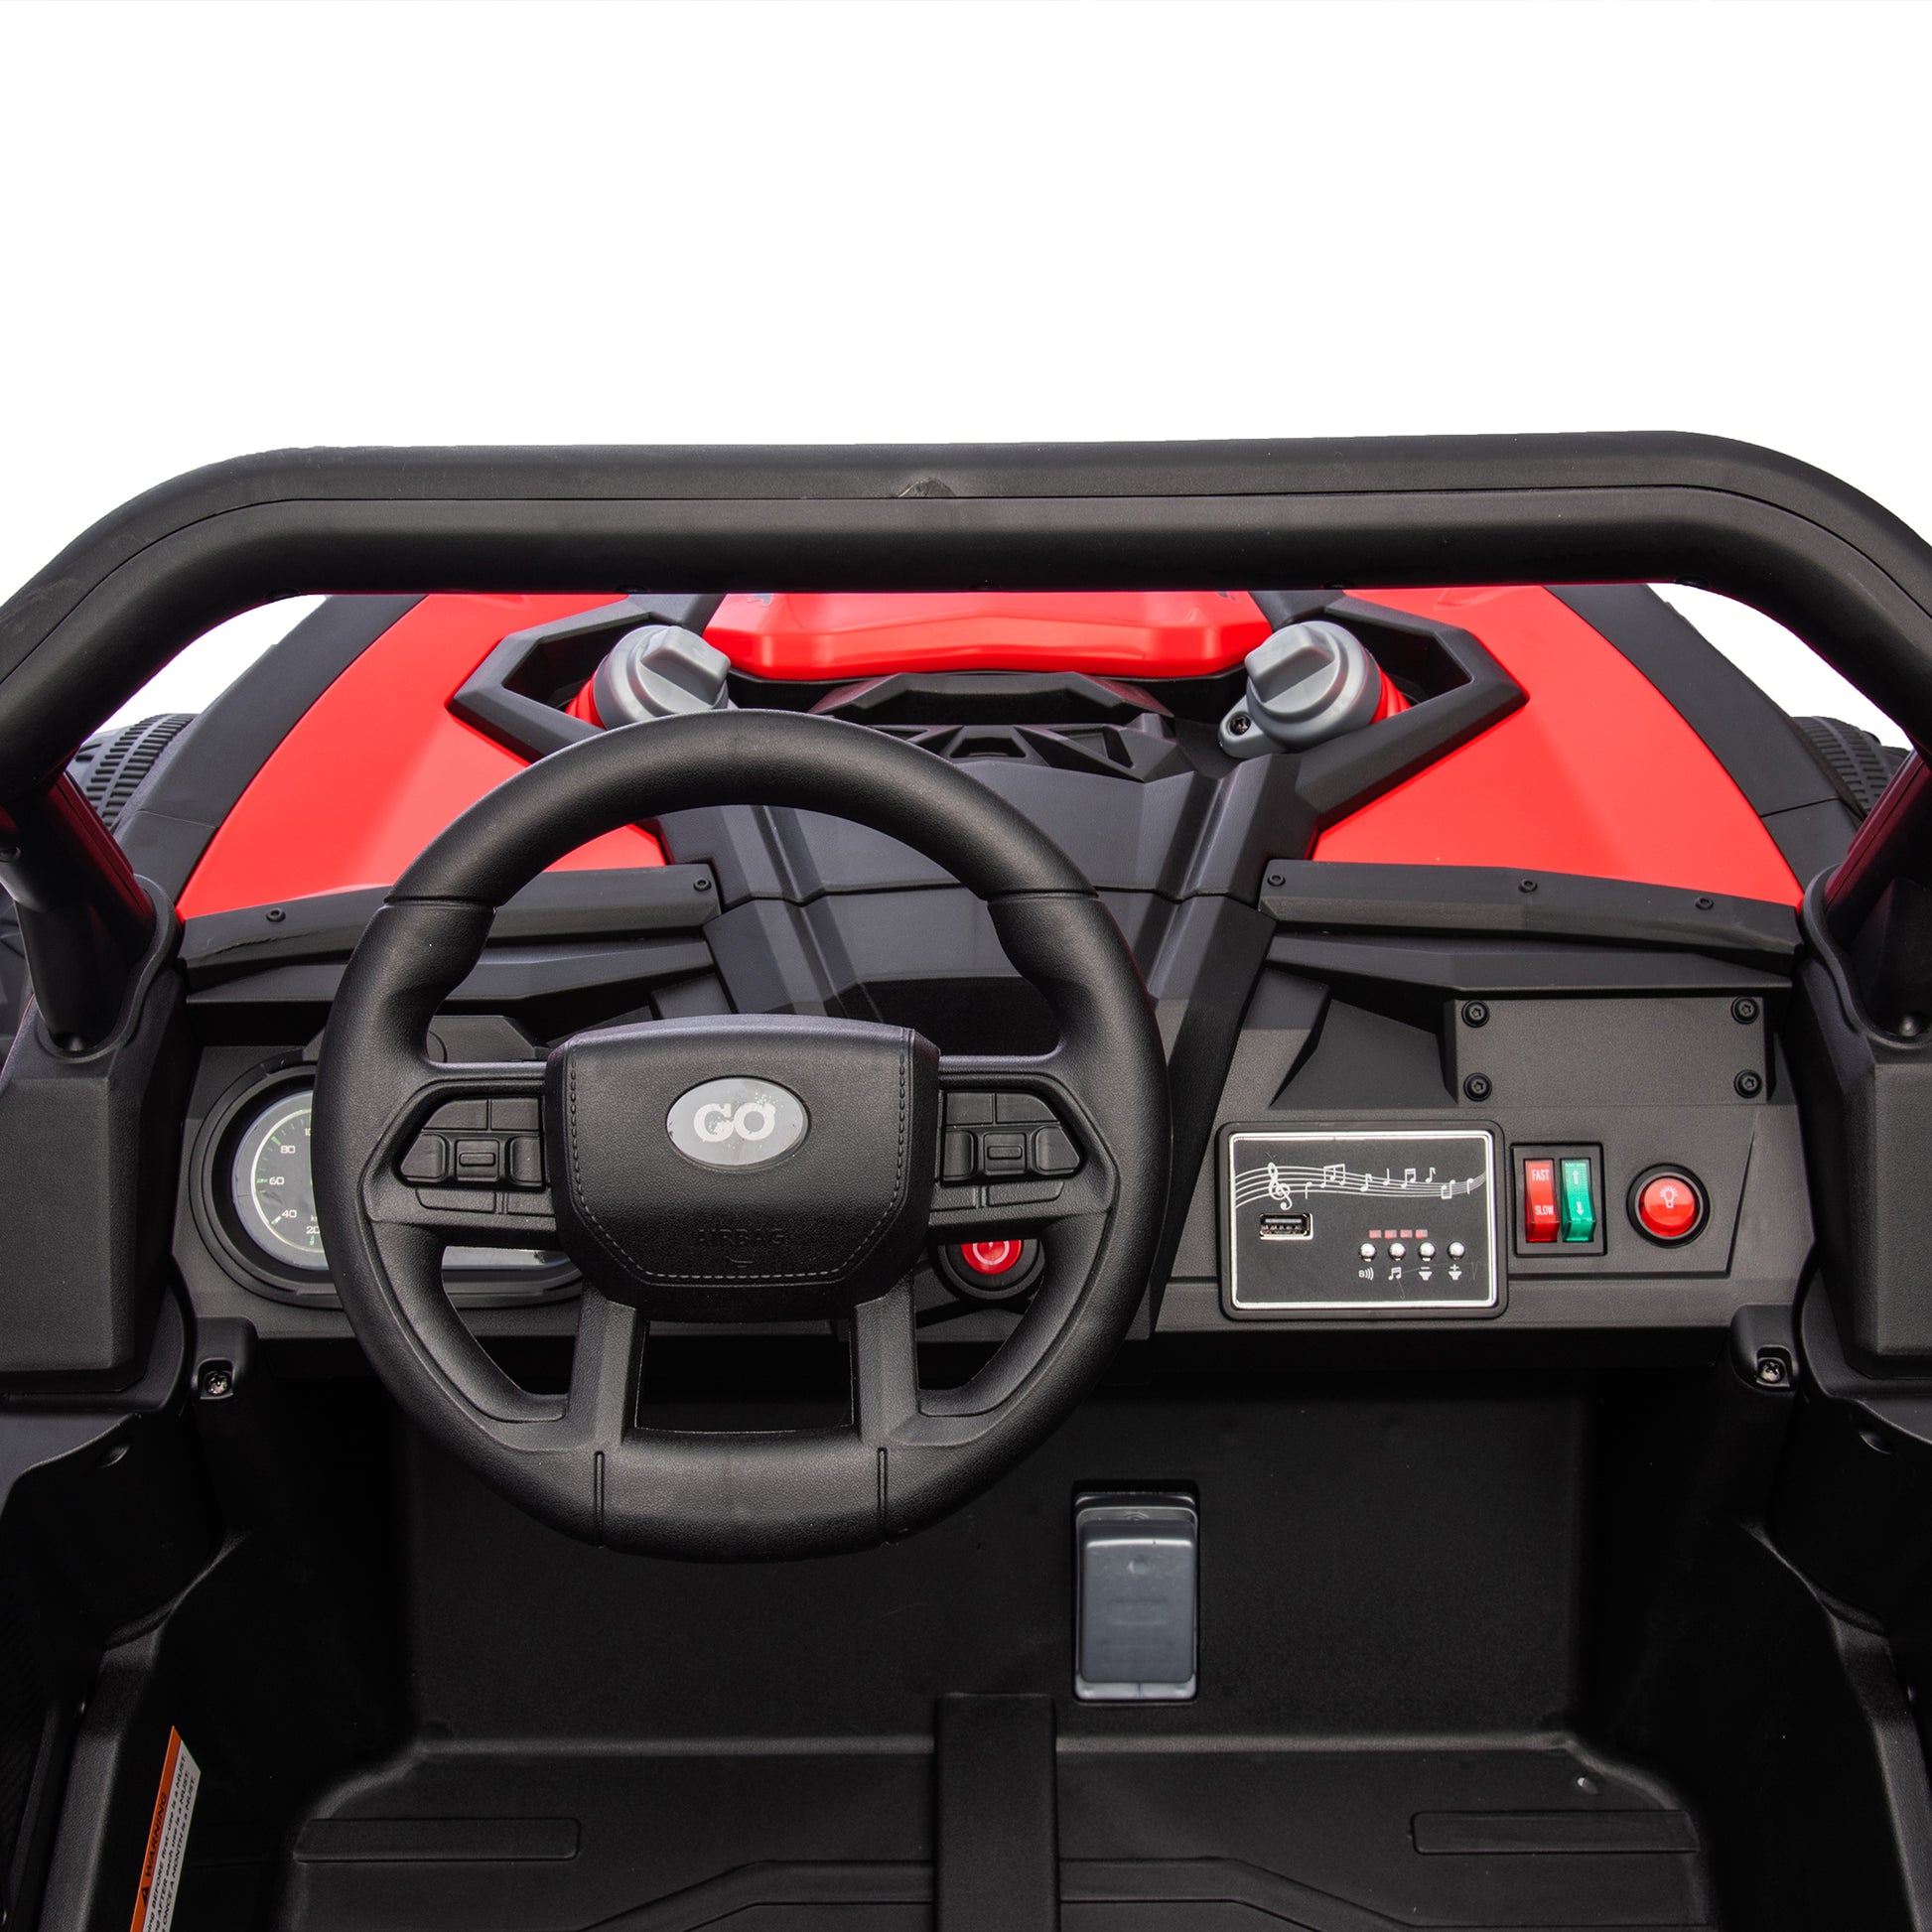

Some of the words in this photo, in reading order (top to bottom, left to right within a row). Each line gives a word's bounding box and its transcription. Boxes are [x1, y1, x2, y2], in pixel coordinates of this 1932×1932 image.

[693, 1103, 776, 1142] GO
[281, 1145, 295, 1154] 80
[1532, 1170, 1549, 1181] FAST
[282, 1209, 297, 1218] 40
[1535, 1205, 1553, 1216] SLOW
[145, 1792, 166, 1877] WARNING
[152, 1862, 164, 1909] BEFORE
[158, 1878, 167, 1918] AFTER
[163, 1891, 172, 1925] ONCE
[172, 1833, 183, 1878] MONTH
